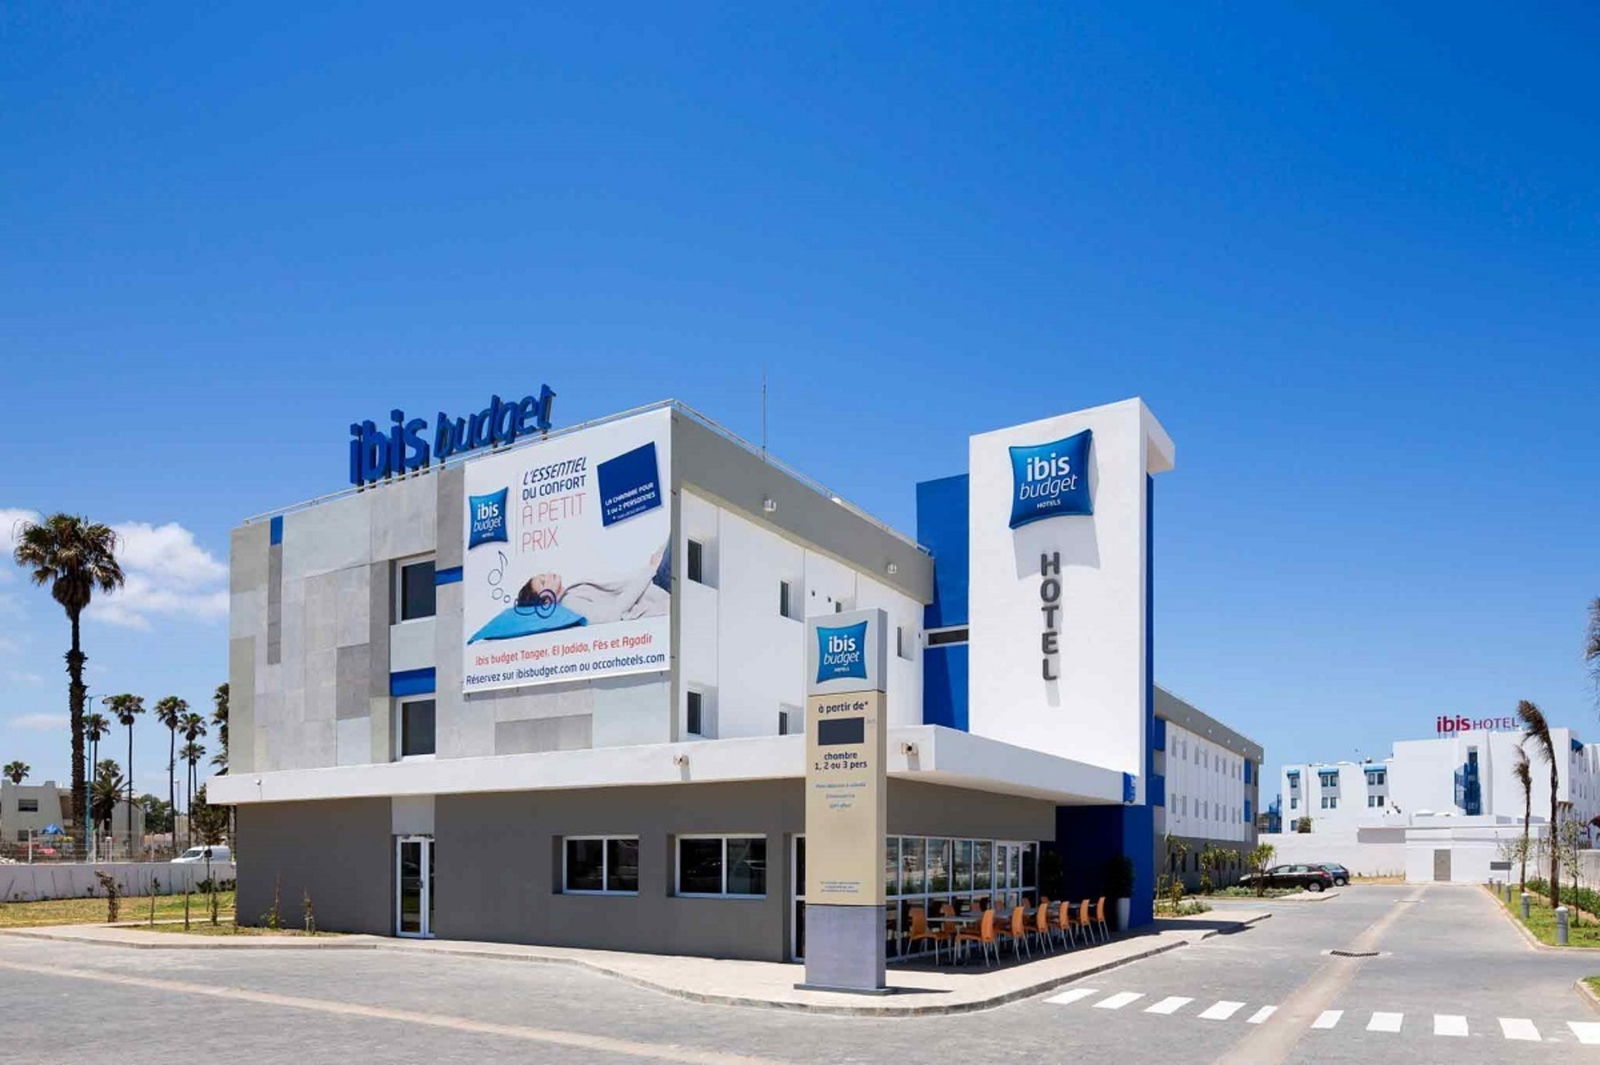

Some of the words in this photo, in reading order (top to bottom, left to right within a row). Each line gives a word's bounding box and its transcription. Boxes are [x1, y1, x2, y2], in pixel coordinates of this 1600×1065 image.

[349, 408, 430, 485] ibis
[433, 383, 556, 459] budget
[1026, 452, 1071, 482] ibis
[522, 486, 537, 501] DU
[538, 474, 587, 497] CONFORT
[1019, 474, 1078, 501] budget
[477, 502, 499, 520] ibis
[522, 500, 533, 526] À
[537, 492, 586, 523] PETIT
[1036, 498, 1062, 509] HOTELS
[472, 515, 502, 533] budget
[521, 526, 559, 553] PRIX
[1040, 551, 1061, 681] HOTEL
[475, 653, 490, 666] ibis
[490, 651, 518, 666] budget
[593, 639, 608, 650] Fès
[610, 639, 620, 649] et
[622, 633, 652, 649] Agadir
[828, 634, 856, 653] ibis
[466, 674, 501, 686] Réservez
[502, 671, 515, 681] sur
[516, 664, 577, 679] ibisbudget.com
[579, 662, 590, 672] ou
[592, 653, 666, 671] accorhotels.com
[823, 651, 860, 666] budget
[818, 702, 824, 714] à
[826, 701, 851, 715] partir
[1436, 714, 1471, 733] ibis
[1472, 717, 1520, 730] HOTEL
[815, 762, 822, 771] 1,
[823, 762, 829, 770] 2
[842, 760, 848, 769] 3
[849, 760, 868, 771] pers
[824, 750, 858, 760] chambre
